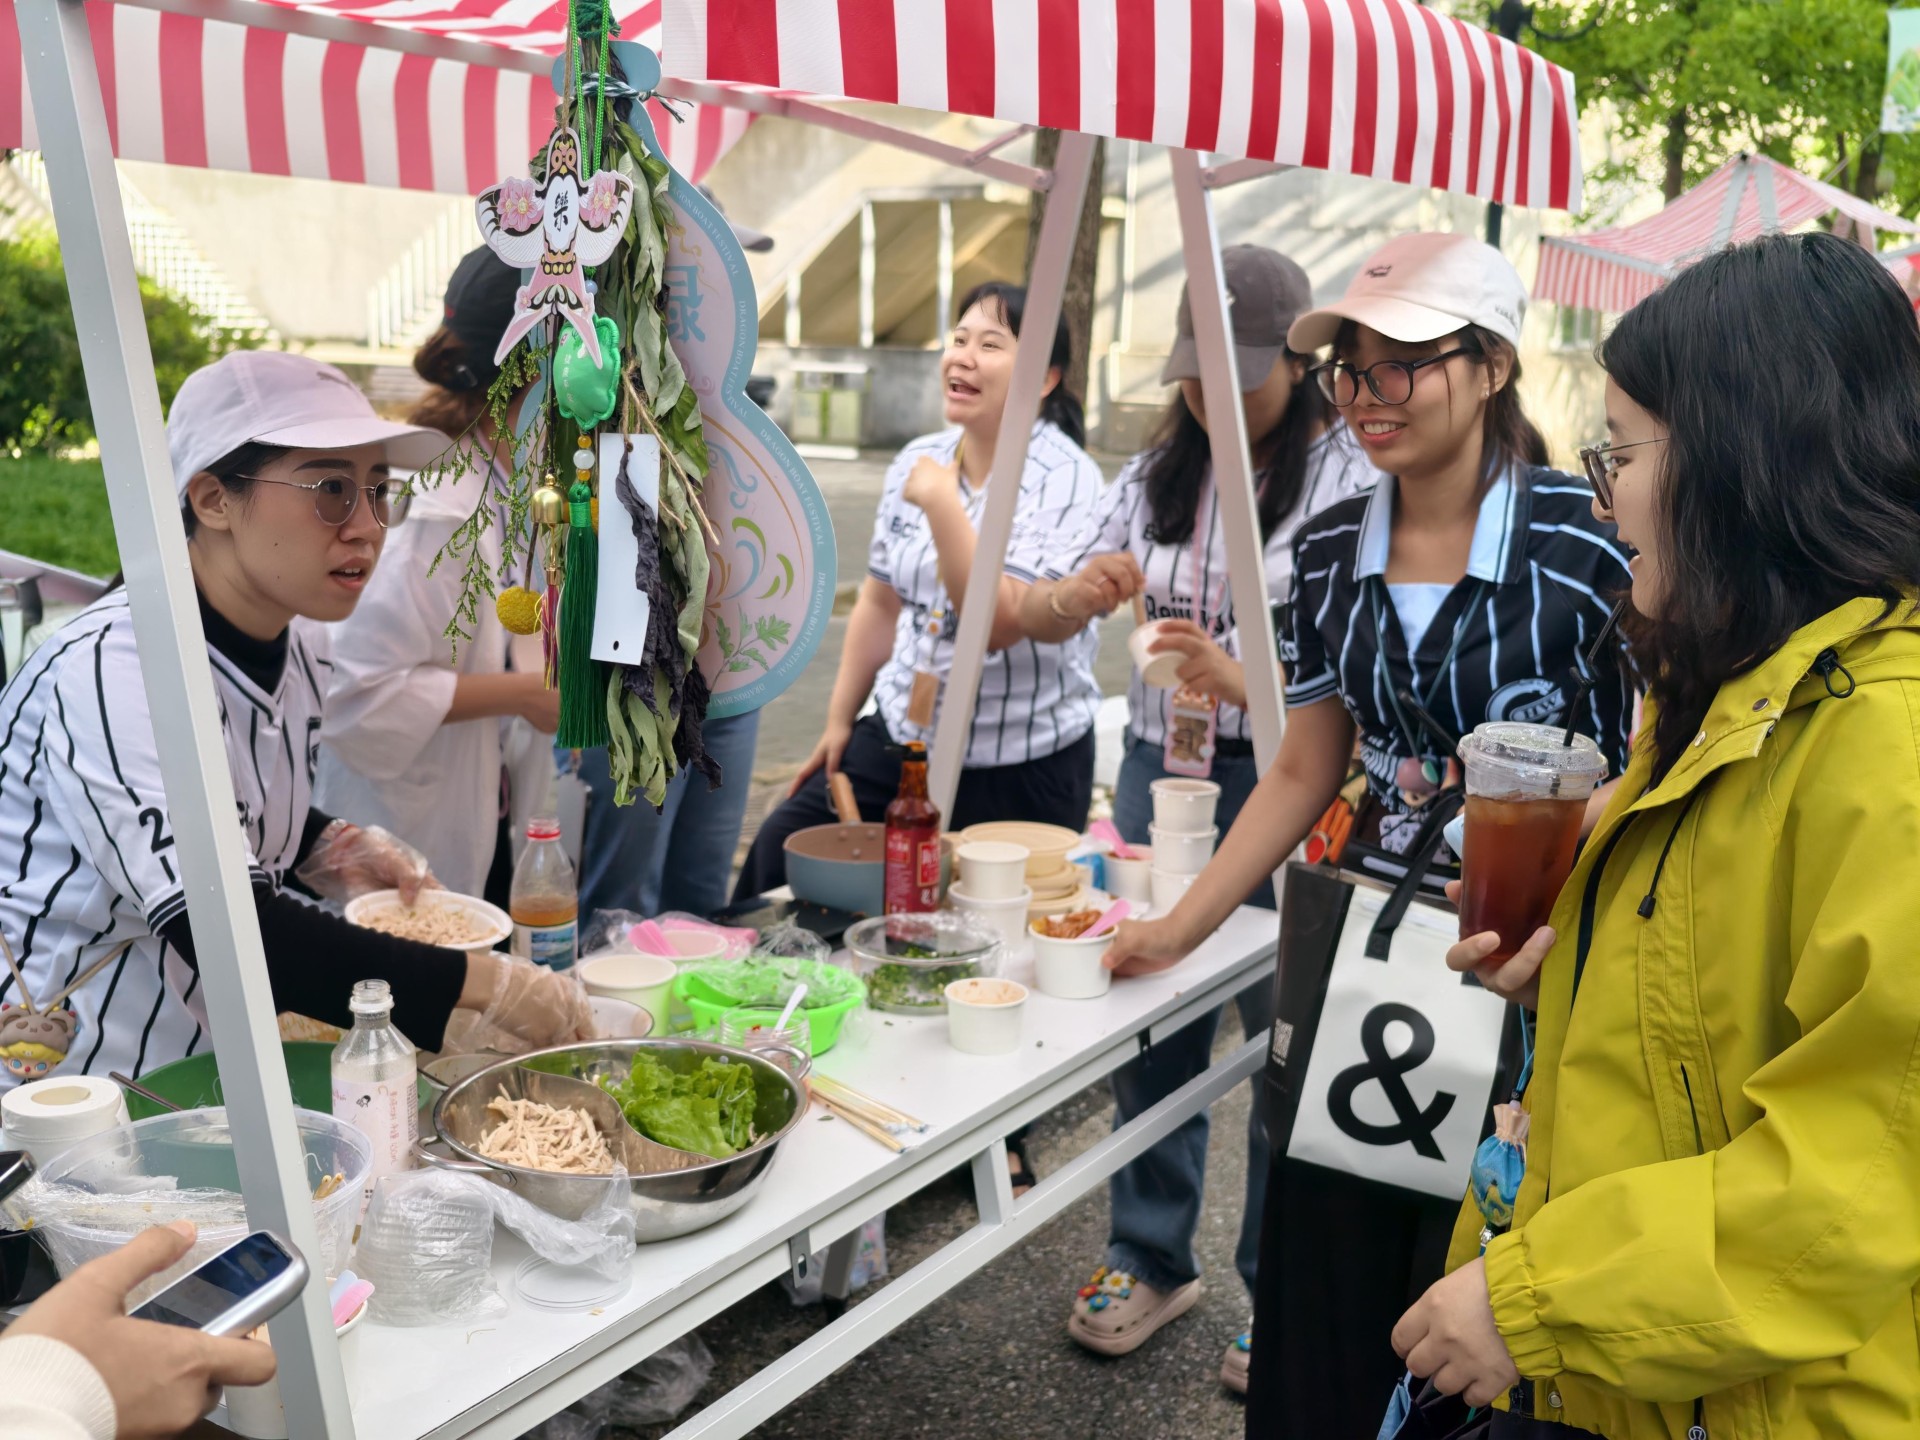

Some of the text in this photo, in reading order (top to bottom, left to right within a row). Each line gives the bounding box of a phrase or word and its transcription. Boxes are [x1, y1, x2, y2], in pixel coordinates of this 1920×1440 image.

[760, 429, 825, 546] DRAGON BOAT FESTIVAL
[777, 572, 826, 677] DRAGON BOAT FESTIVAL
[138, 806, 175, 854] 2
